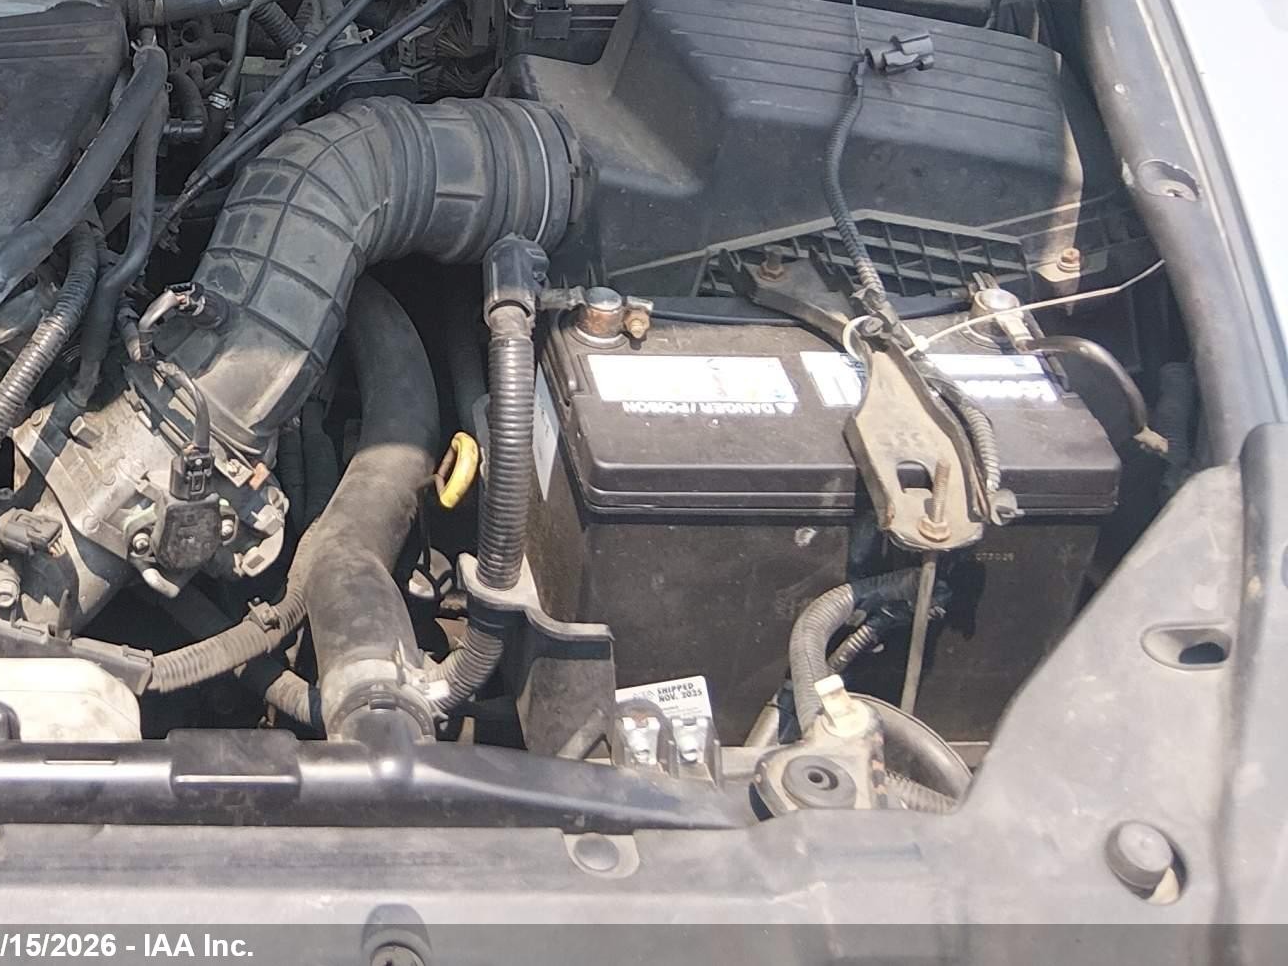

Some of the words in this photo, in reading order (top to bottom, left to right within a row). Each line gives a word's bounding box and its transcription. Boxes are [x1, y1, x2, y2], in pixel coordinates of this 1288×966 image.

[699, 401, 776, 414] DANGER
[657, 682, 694, 694] SHIPPED
[658, 692, 679, 703] NOV.
